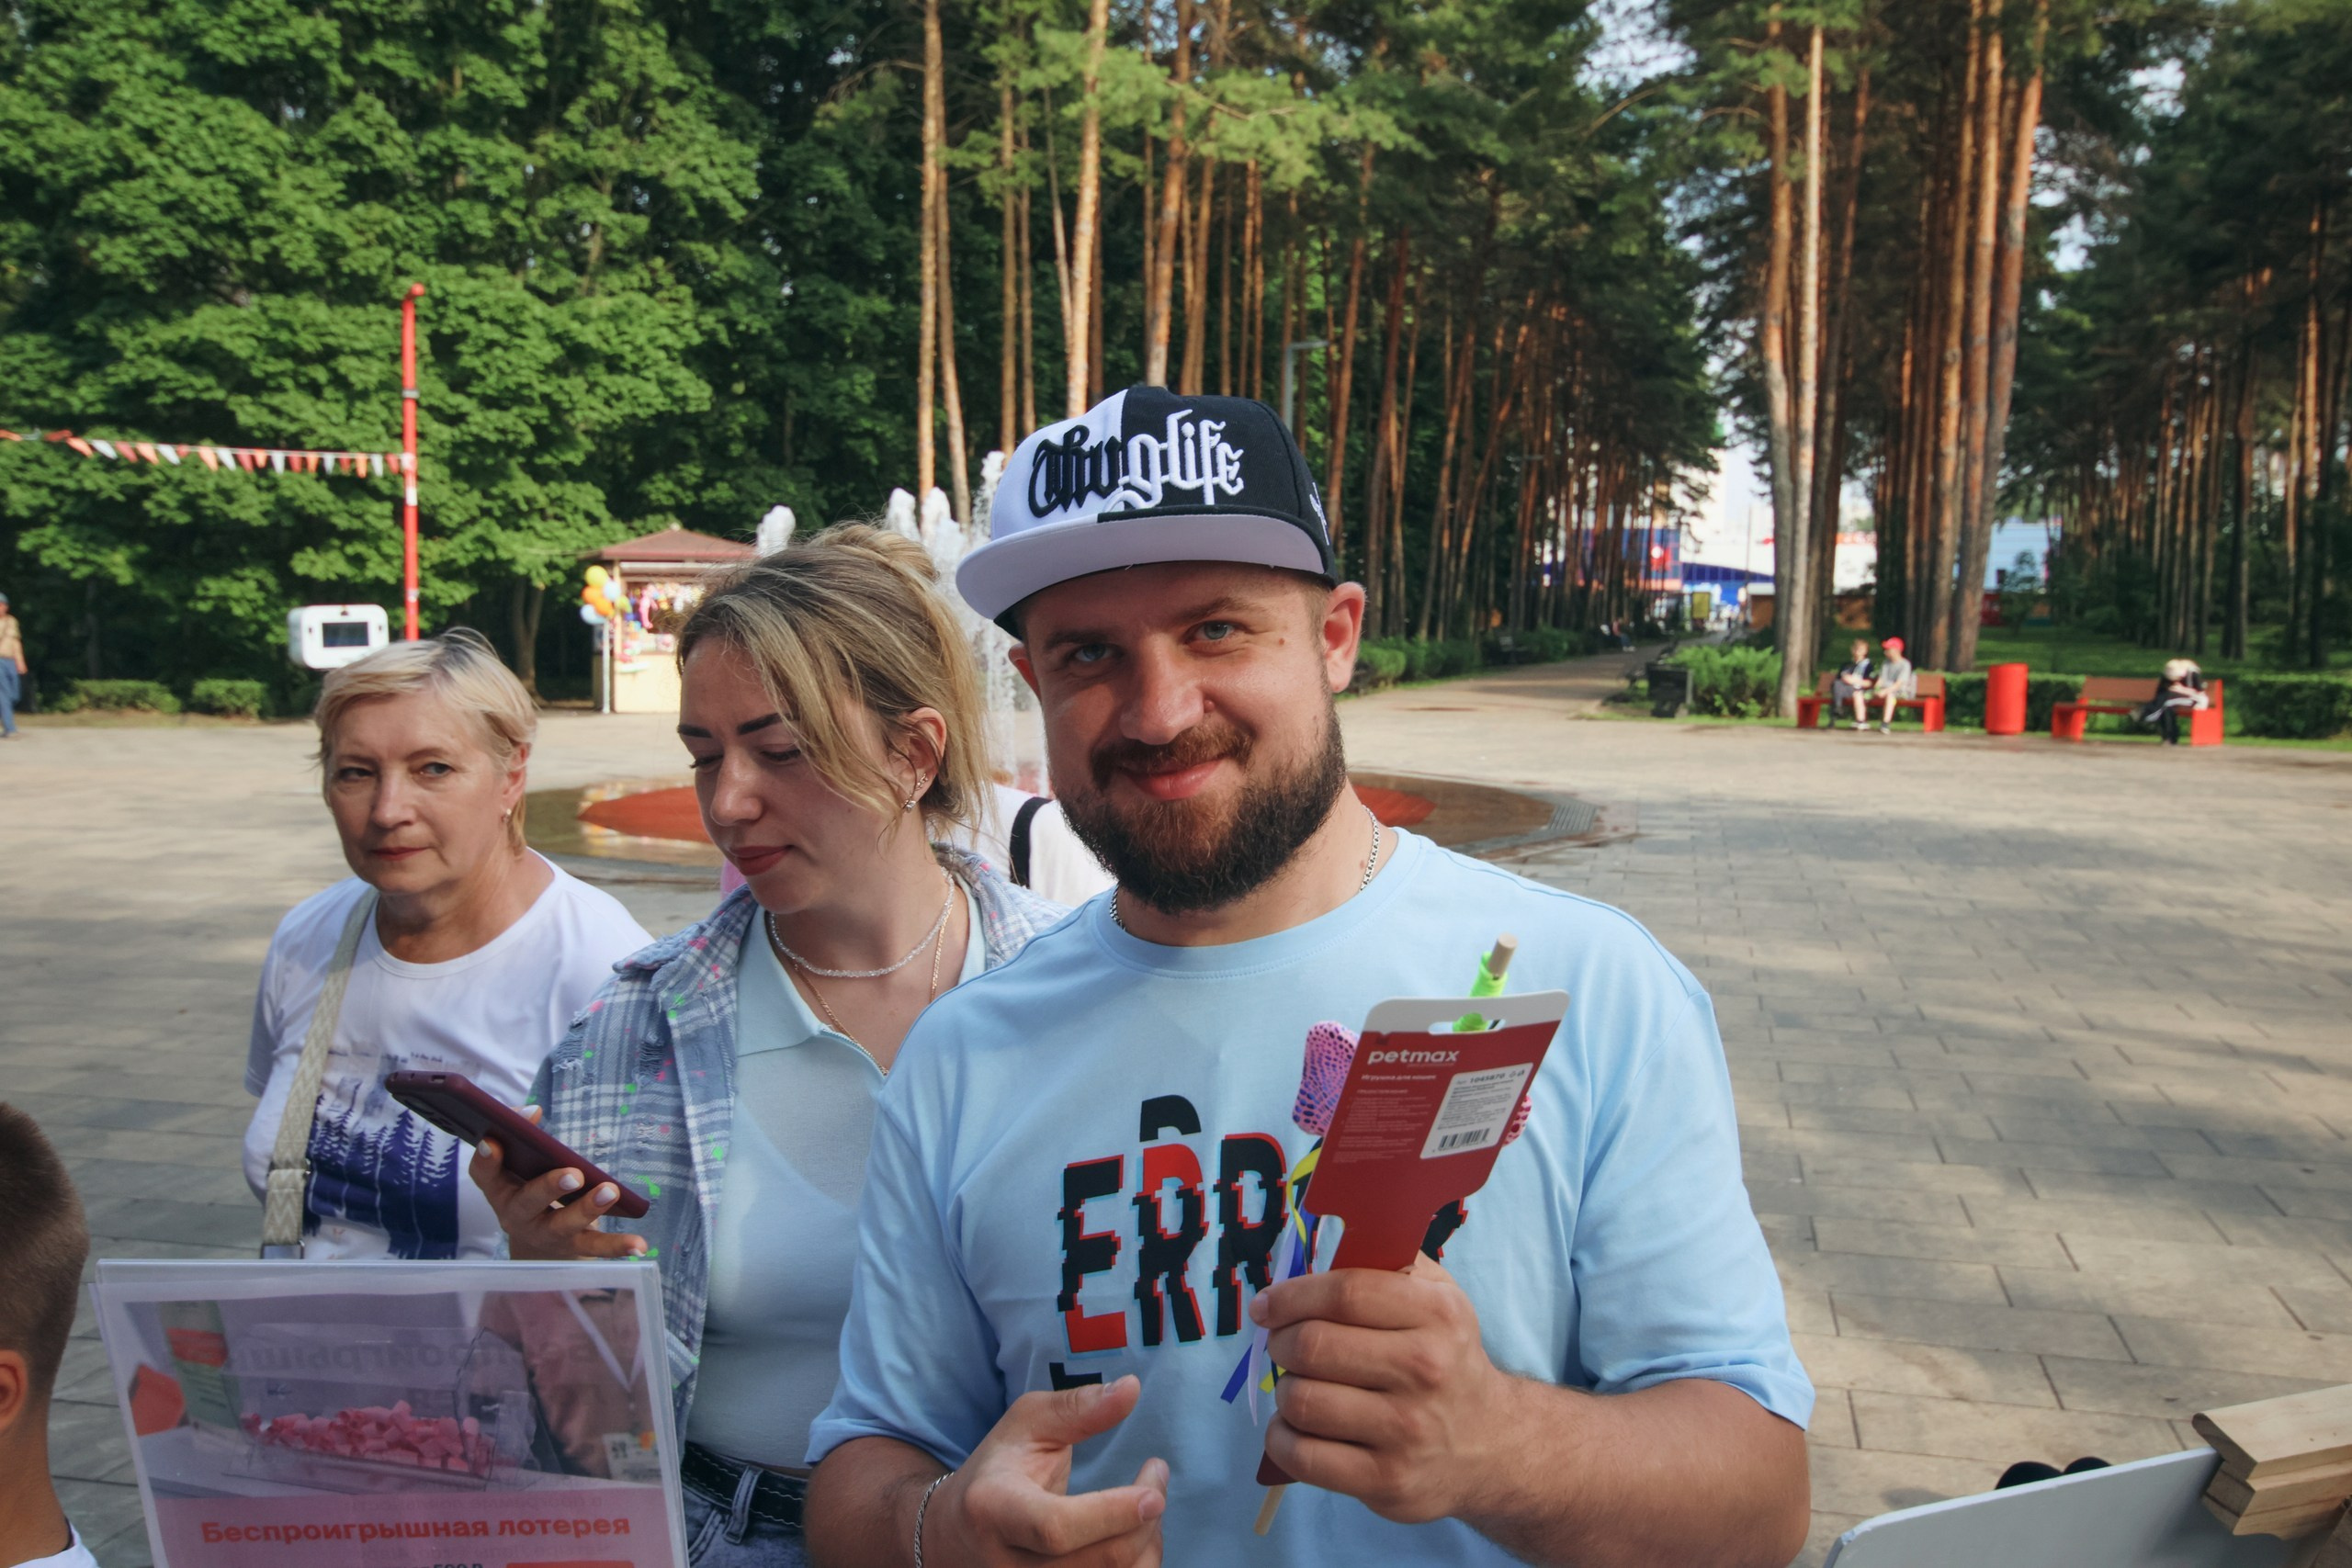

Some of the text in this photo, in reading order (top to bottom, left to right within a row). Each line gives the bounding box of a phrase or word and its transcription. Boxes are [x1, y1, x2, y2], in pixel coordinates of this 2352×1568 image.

[1367, 1049, 1460, 1066] petmax
[201, 1517, 631, 1544] Беспроигрышная лотерея
